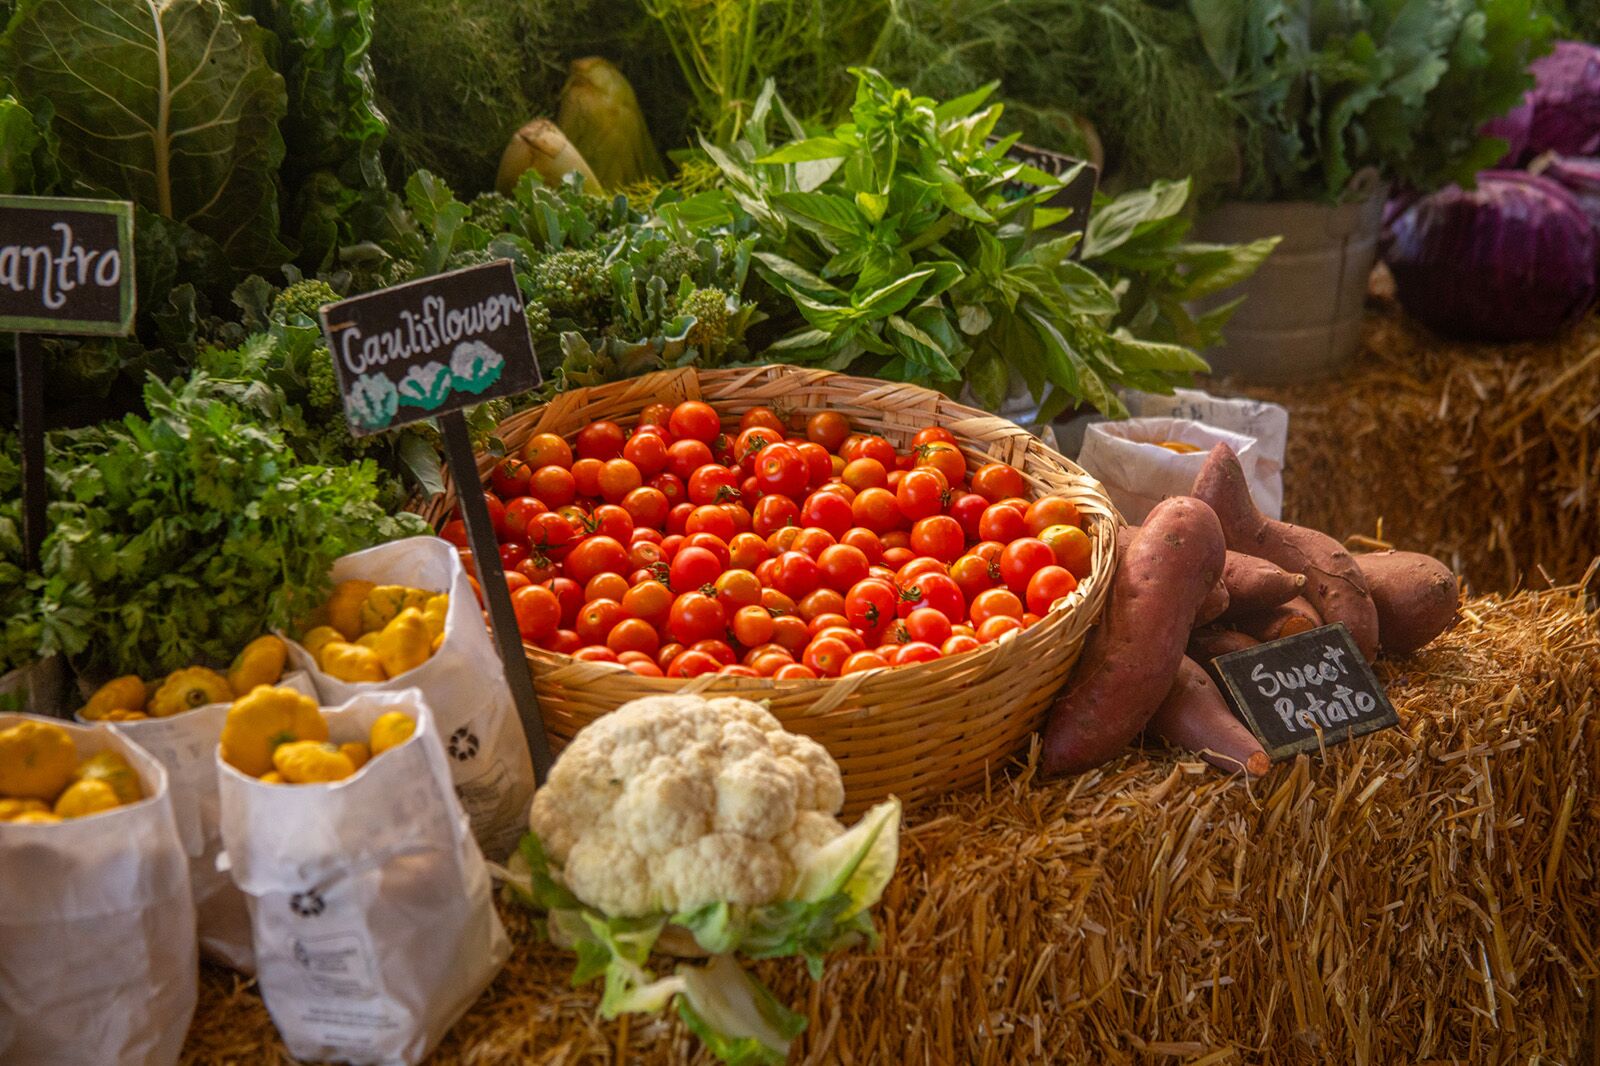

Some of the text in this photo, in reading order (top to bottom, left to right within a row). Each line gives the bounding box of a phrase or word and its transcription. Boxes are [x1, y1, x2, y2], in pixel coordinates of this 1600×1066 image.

[342, 294, 521, 374] Cauliflower
[1251, 645, 1349, 697] Sweet
[1273, 684, 1376, 732] Potato
